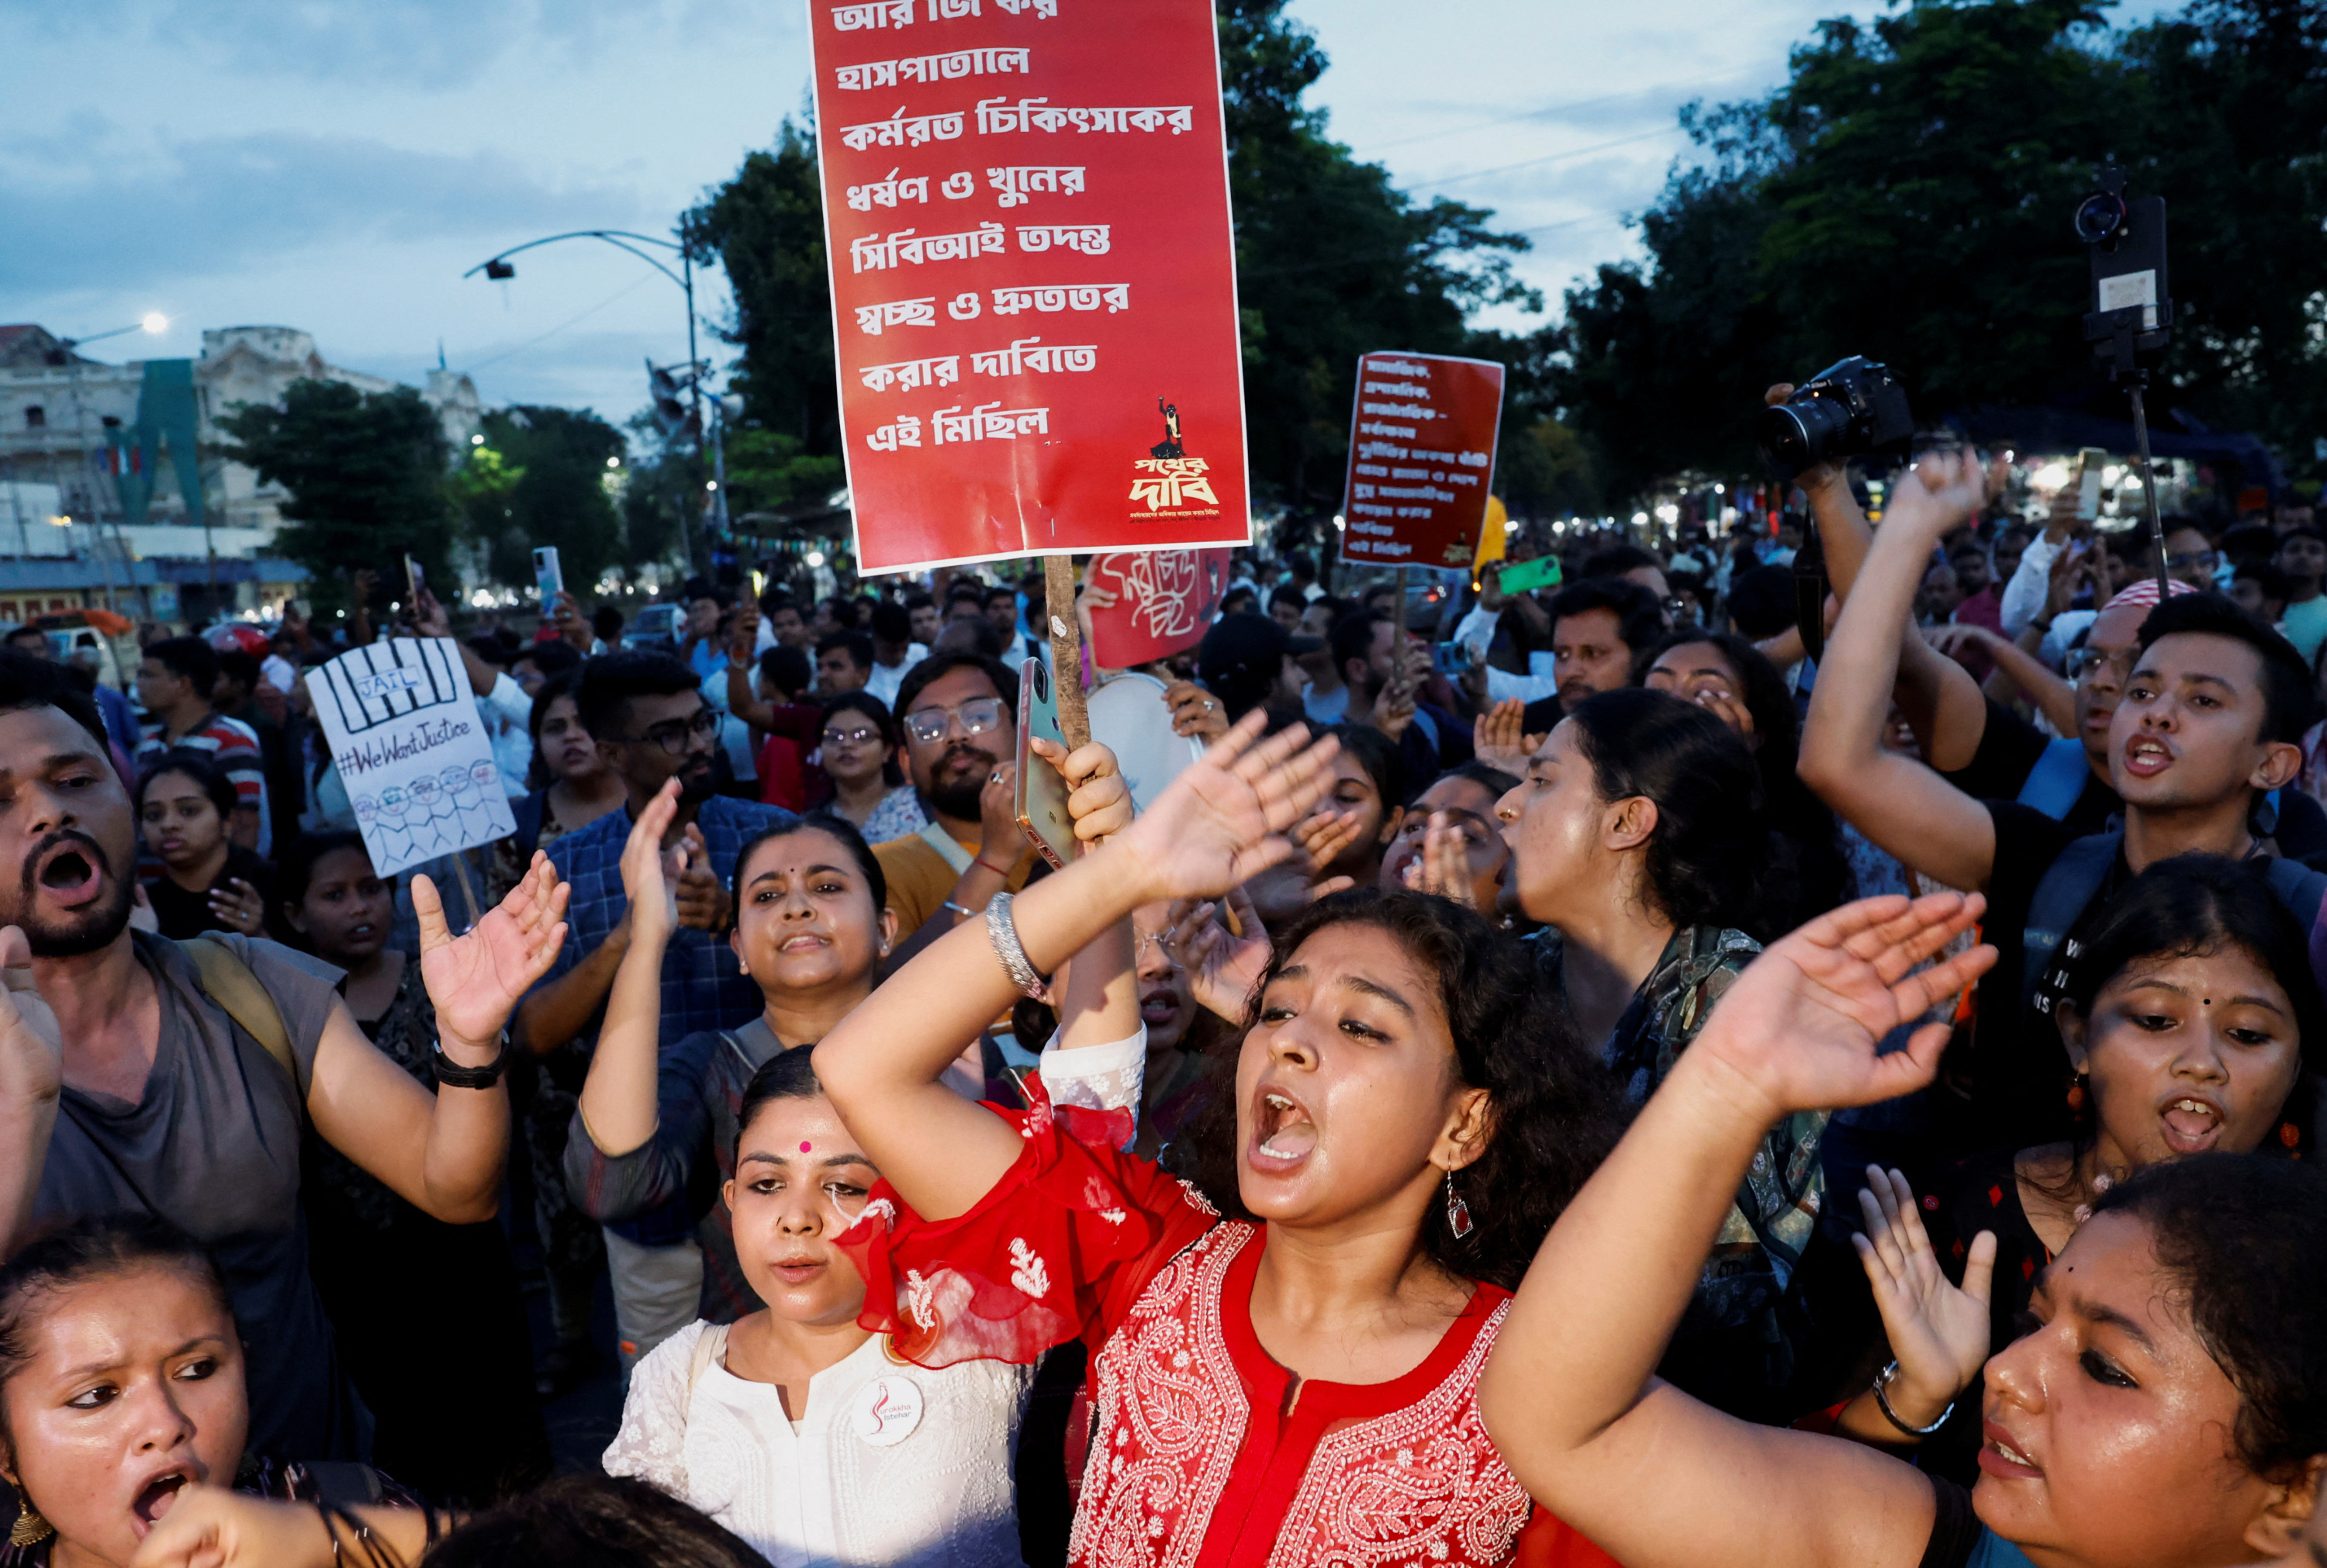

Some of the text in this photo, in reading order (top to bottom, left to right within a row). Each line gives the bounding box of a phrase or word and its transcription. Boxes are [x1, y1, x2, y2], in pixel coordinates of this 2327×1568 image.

[831, 0, 915, 31] আর
[835, 48, 1030, 90] হাসপাতালে
[840, 97, 1193, 151] কর্মরত চিকিৎসকের
[846, 167, 1085, 211] ধর্ষণ ও খুনের
[849, 221, 1110, 274] সিবিআই তদন্ত
[855, 284, 1129, 336] স্বচ্ছ ও দ্রুততর
[859, 337, 1098, 395] করার দাবিতে
[866, 401, 1049, 451] এই মিছিল
[1135, 458, 1209, 477] পথের
[1129, 470, 1220, 512] দাবি
[358, 672, 418, 697] JAIL
[339, 718, 471, 776] #WeWantJustice
[884, 1411, 911, 1421] Istehar
